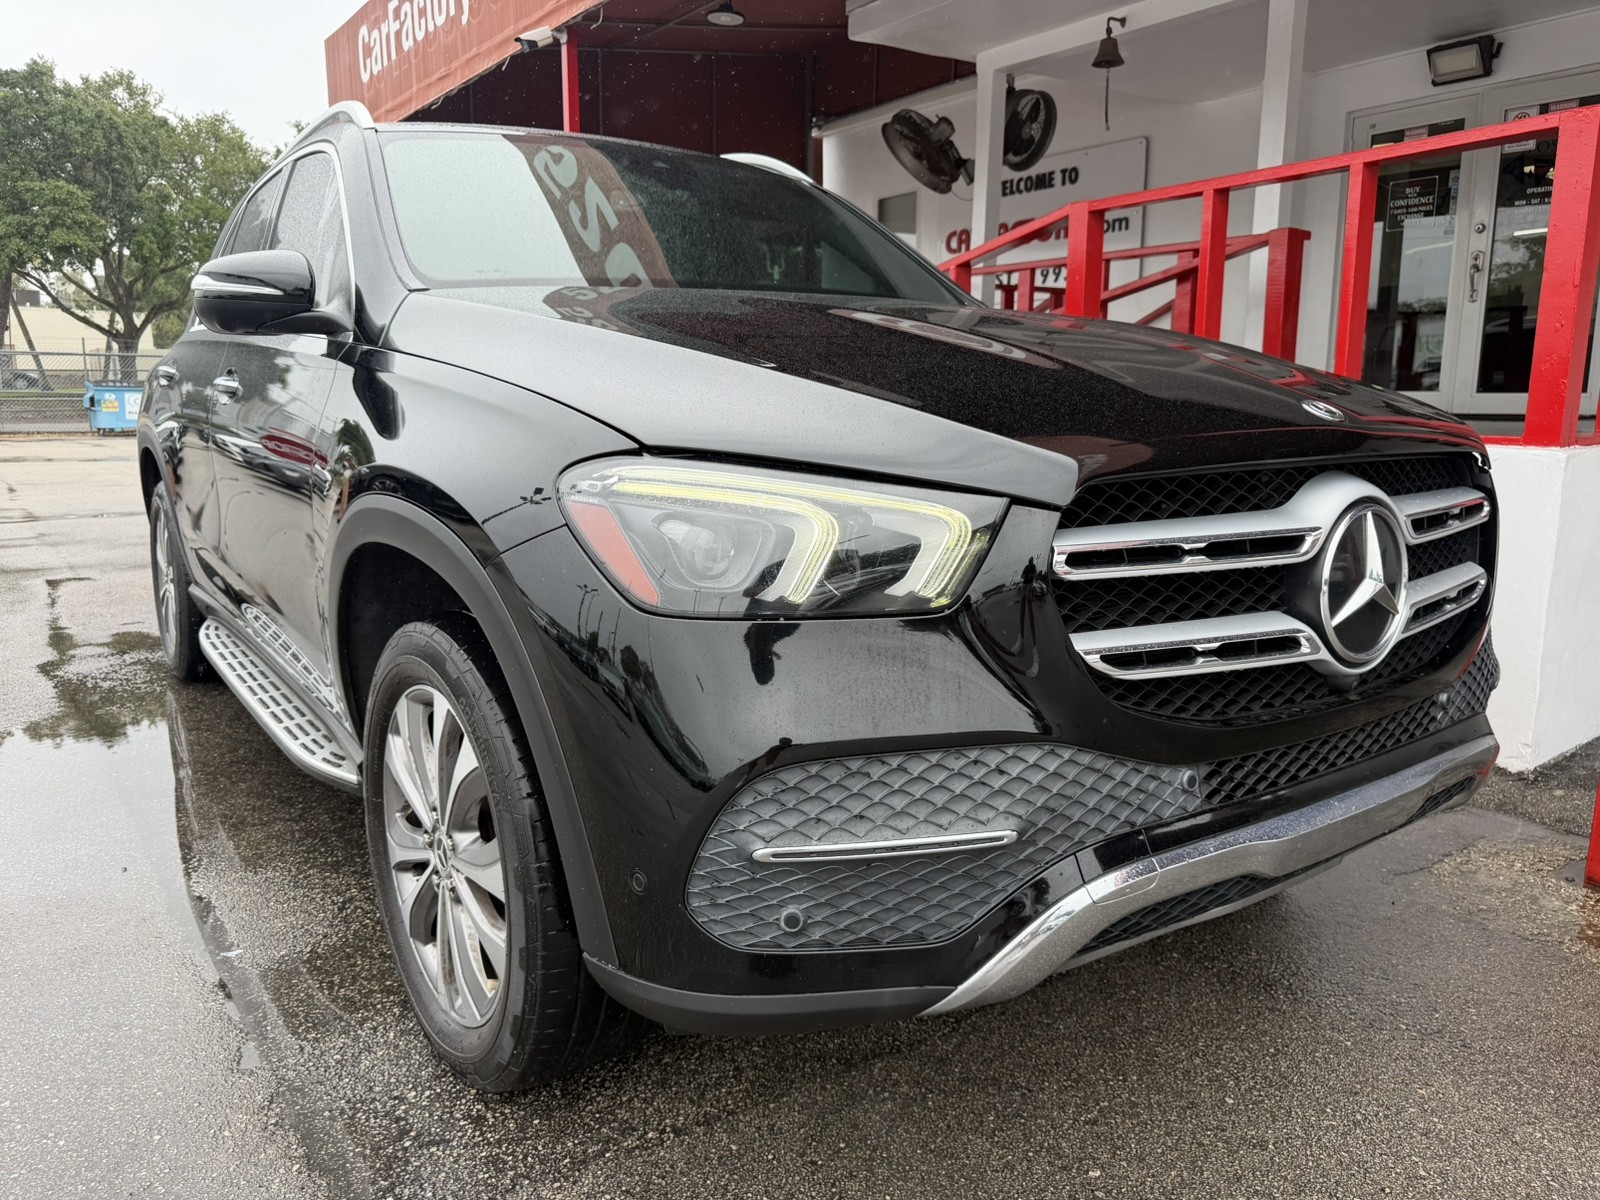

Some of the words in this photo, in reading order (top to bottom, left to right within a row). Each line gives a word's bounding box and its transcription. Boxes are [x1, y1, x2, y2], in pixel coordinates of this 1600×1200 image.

[1001, 170, 1055, 198] ELCOME
[1059, 166, 1079, 187] TO
[1405, 186, 1420, 194] BUY
[1526, 186, 1552, 194] OPERATIN
[1390, 195, 1434, 208] CONFIDENCE
